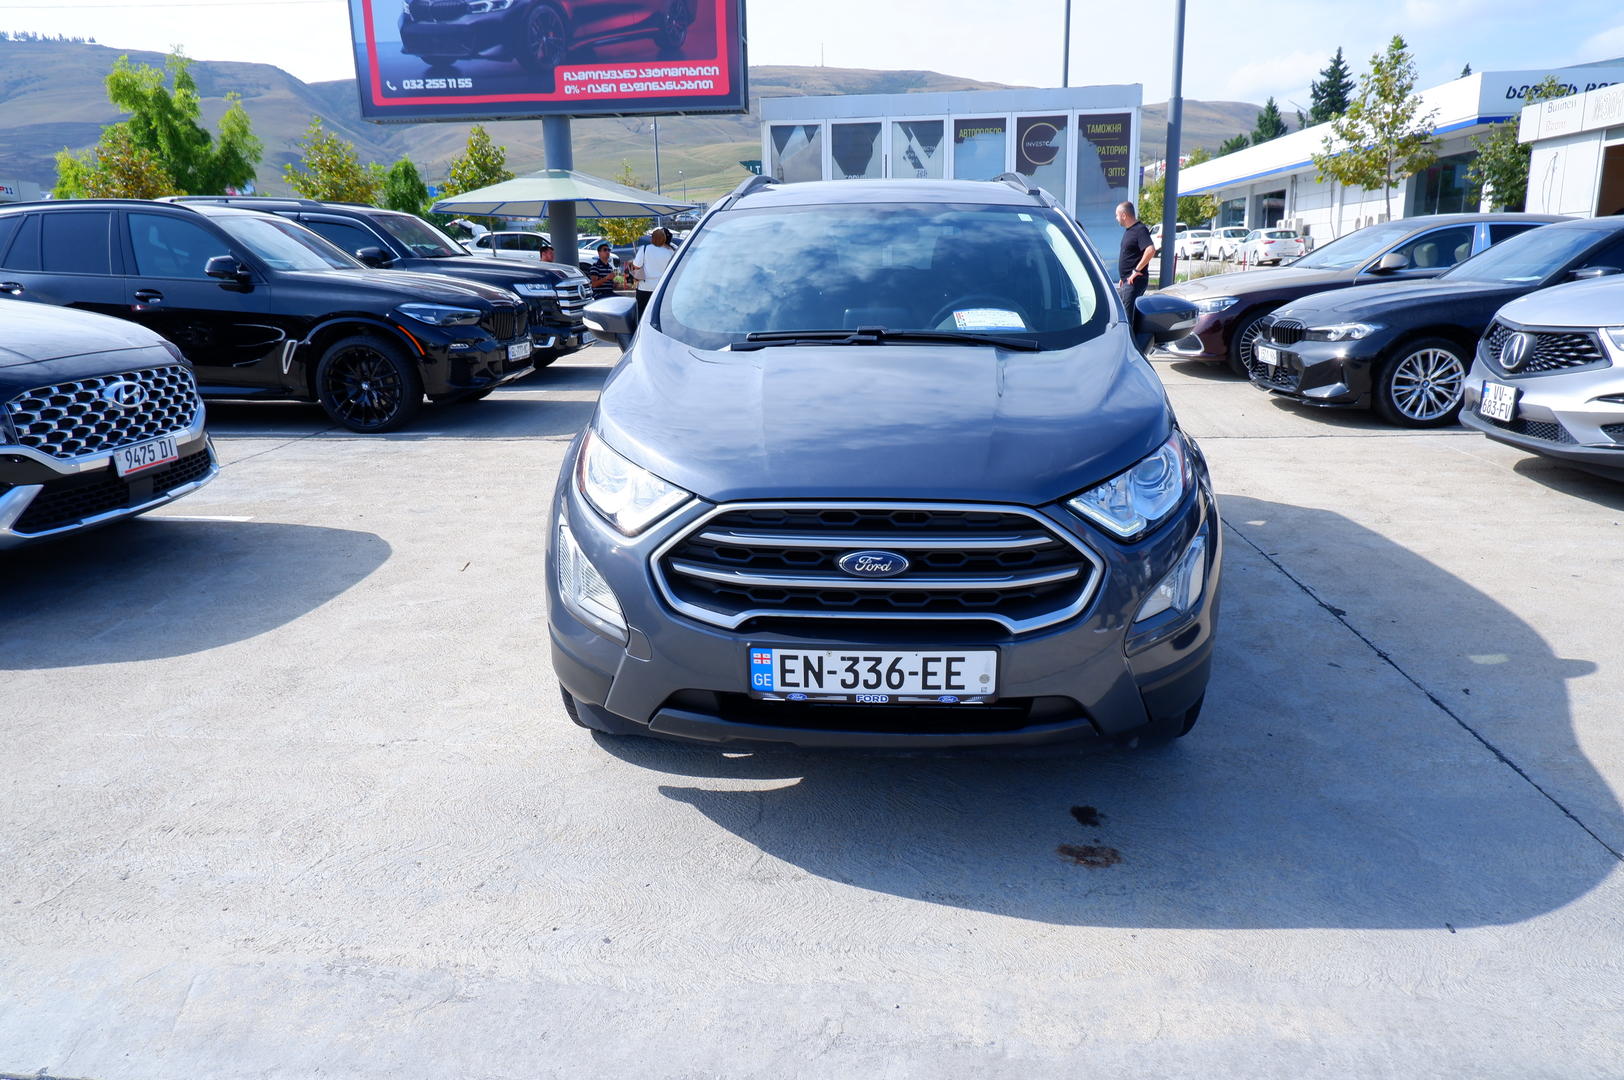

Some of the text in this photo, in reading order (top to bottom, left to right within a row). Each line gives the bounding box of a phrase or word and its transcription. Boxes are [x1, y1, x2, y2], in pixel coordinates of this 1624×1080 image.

[402, 78, 473, 90] 032 255 11 55
[1086, 123, 1122, 134] ТАМОЖНЯ
[125, 444, 155, 468] 9475
[855, 556, 892, 572] Ford
[779, 654, 966, 690] EN-336-EE
[754, 673, 772, 686] GE
[856, 694, 889, 703] FORD
